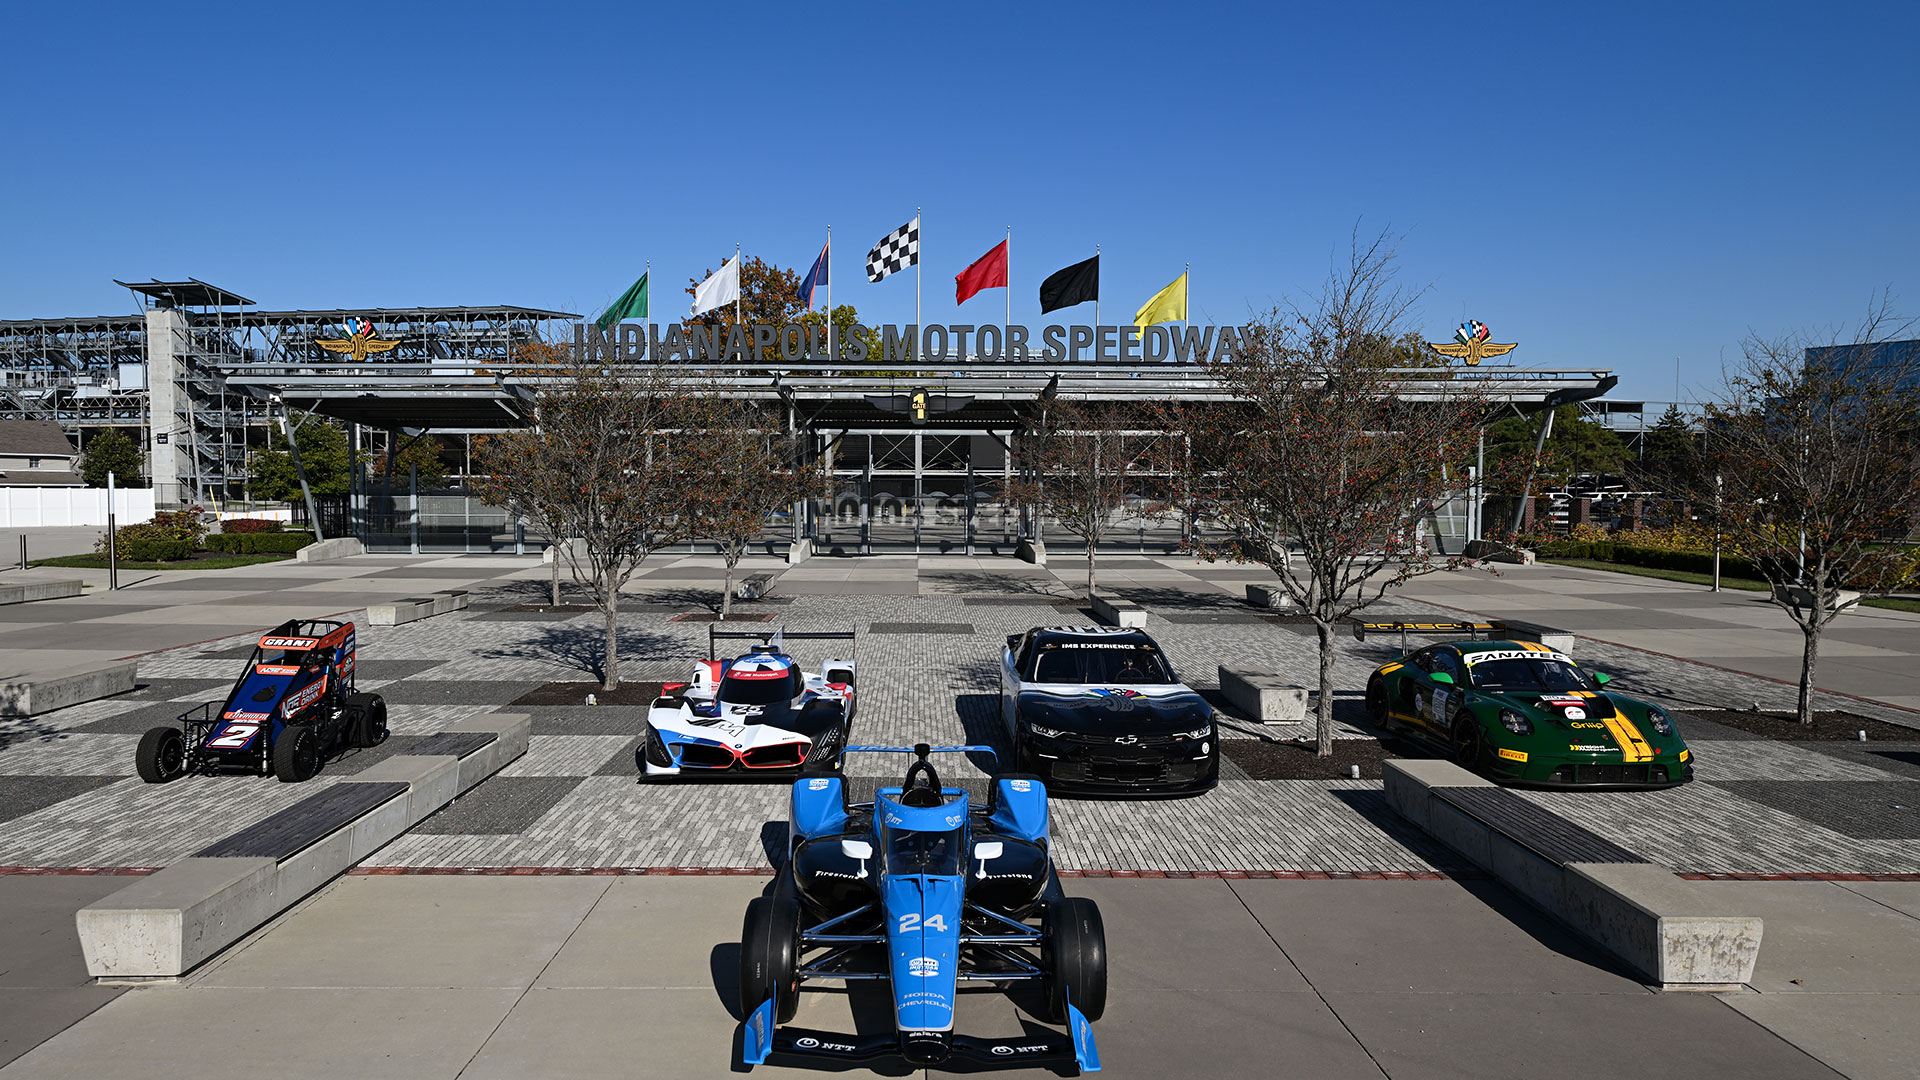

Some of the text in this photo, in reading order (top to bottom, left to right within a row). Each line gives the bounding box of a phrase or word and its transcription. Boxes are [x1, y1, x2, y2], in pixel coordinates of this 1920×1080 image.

[574, 324, 1265, 362] INDIANAPOLIS MOTOR SPEEDWAY
[913, 393, 925, 420] 1
[264, 638, 315, 648] GRANT
[1471, 651, 1564, 664] FANATEC
[302, 679, 324, 697] ENERGY
[301, 691, 319, 706] DRINK
[210, 724, 261, 747] 2
[1500, 749, 1526, 760] PIRELLI
[815, 870, 859, 880] Firestone
[899, 913, 948, 934] 24
[904, 992, 946, 1000] HONDA
[897, 1000, 952, 1011] CHEVROLET
[821, 1042, 856, 1052] NTT
[1016, 1044, 1048, 1053] NTT
